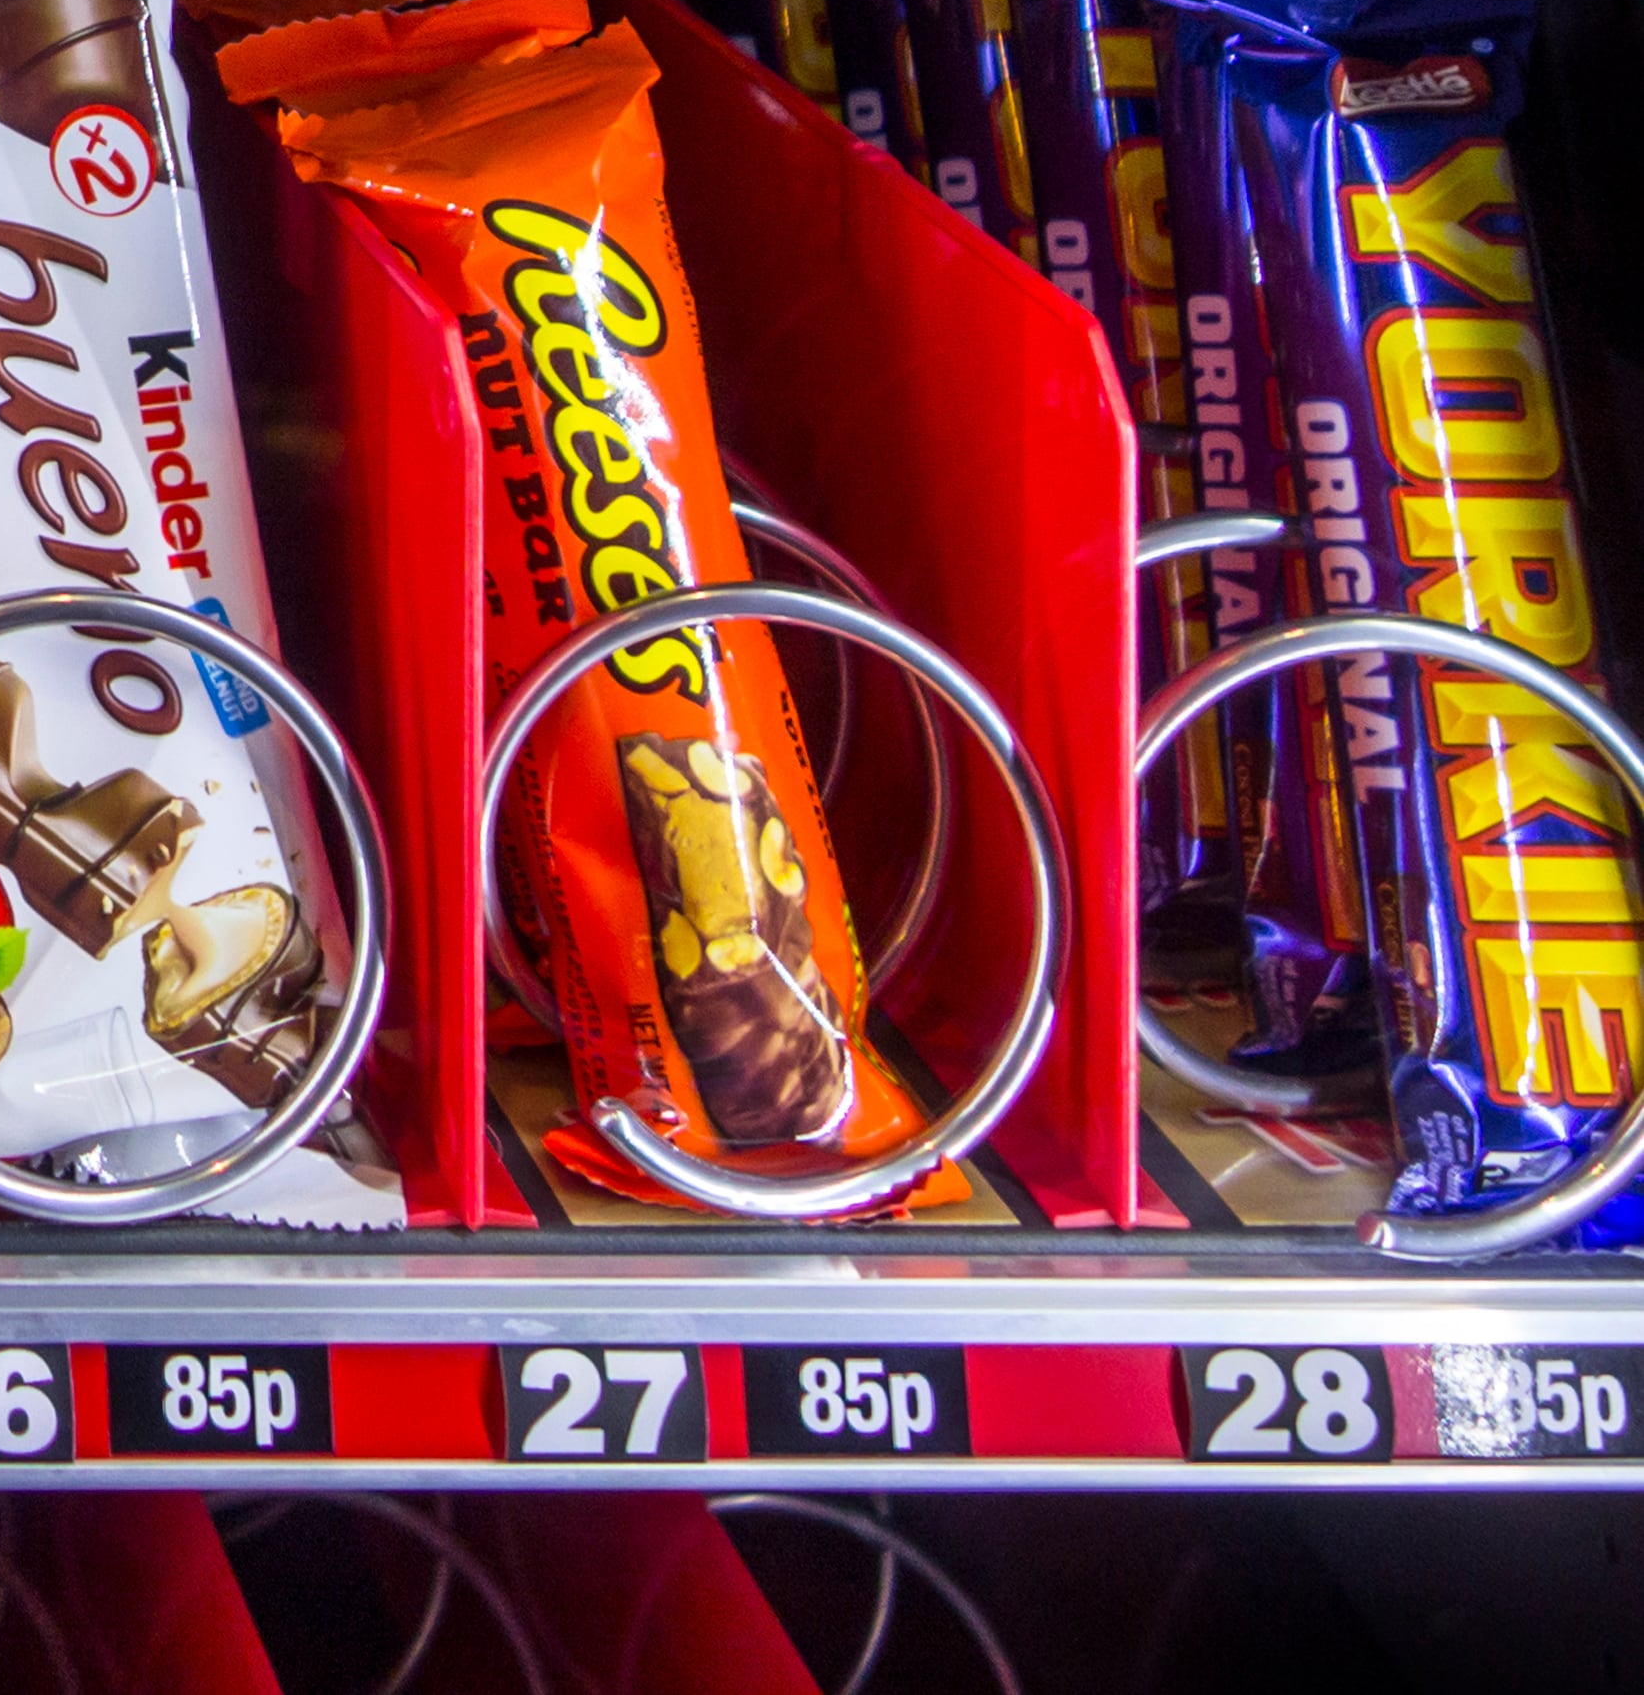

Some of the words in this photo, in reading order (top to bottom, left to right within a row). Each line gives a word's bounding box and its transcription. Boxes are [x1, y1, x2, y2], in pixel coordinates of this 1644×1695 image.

[126, 329, 212, 581] Kinder
[483, 197, 723, 707] Reese's
[1297, 400, 1407, 804] ORIGNAL
[1346, 141, 1642, 1095] YORKIE
[624, 1000, 661, 1053] NET
[165, 1357, 295, 1445] 85p
[522, 1349, 686, 1453] 27
[800, 1359, 932, 1448] 85p
[1206, 1349, 1376, 1452] 28
